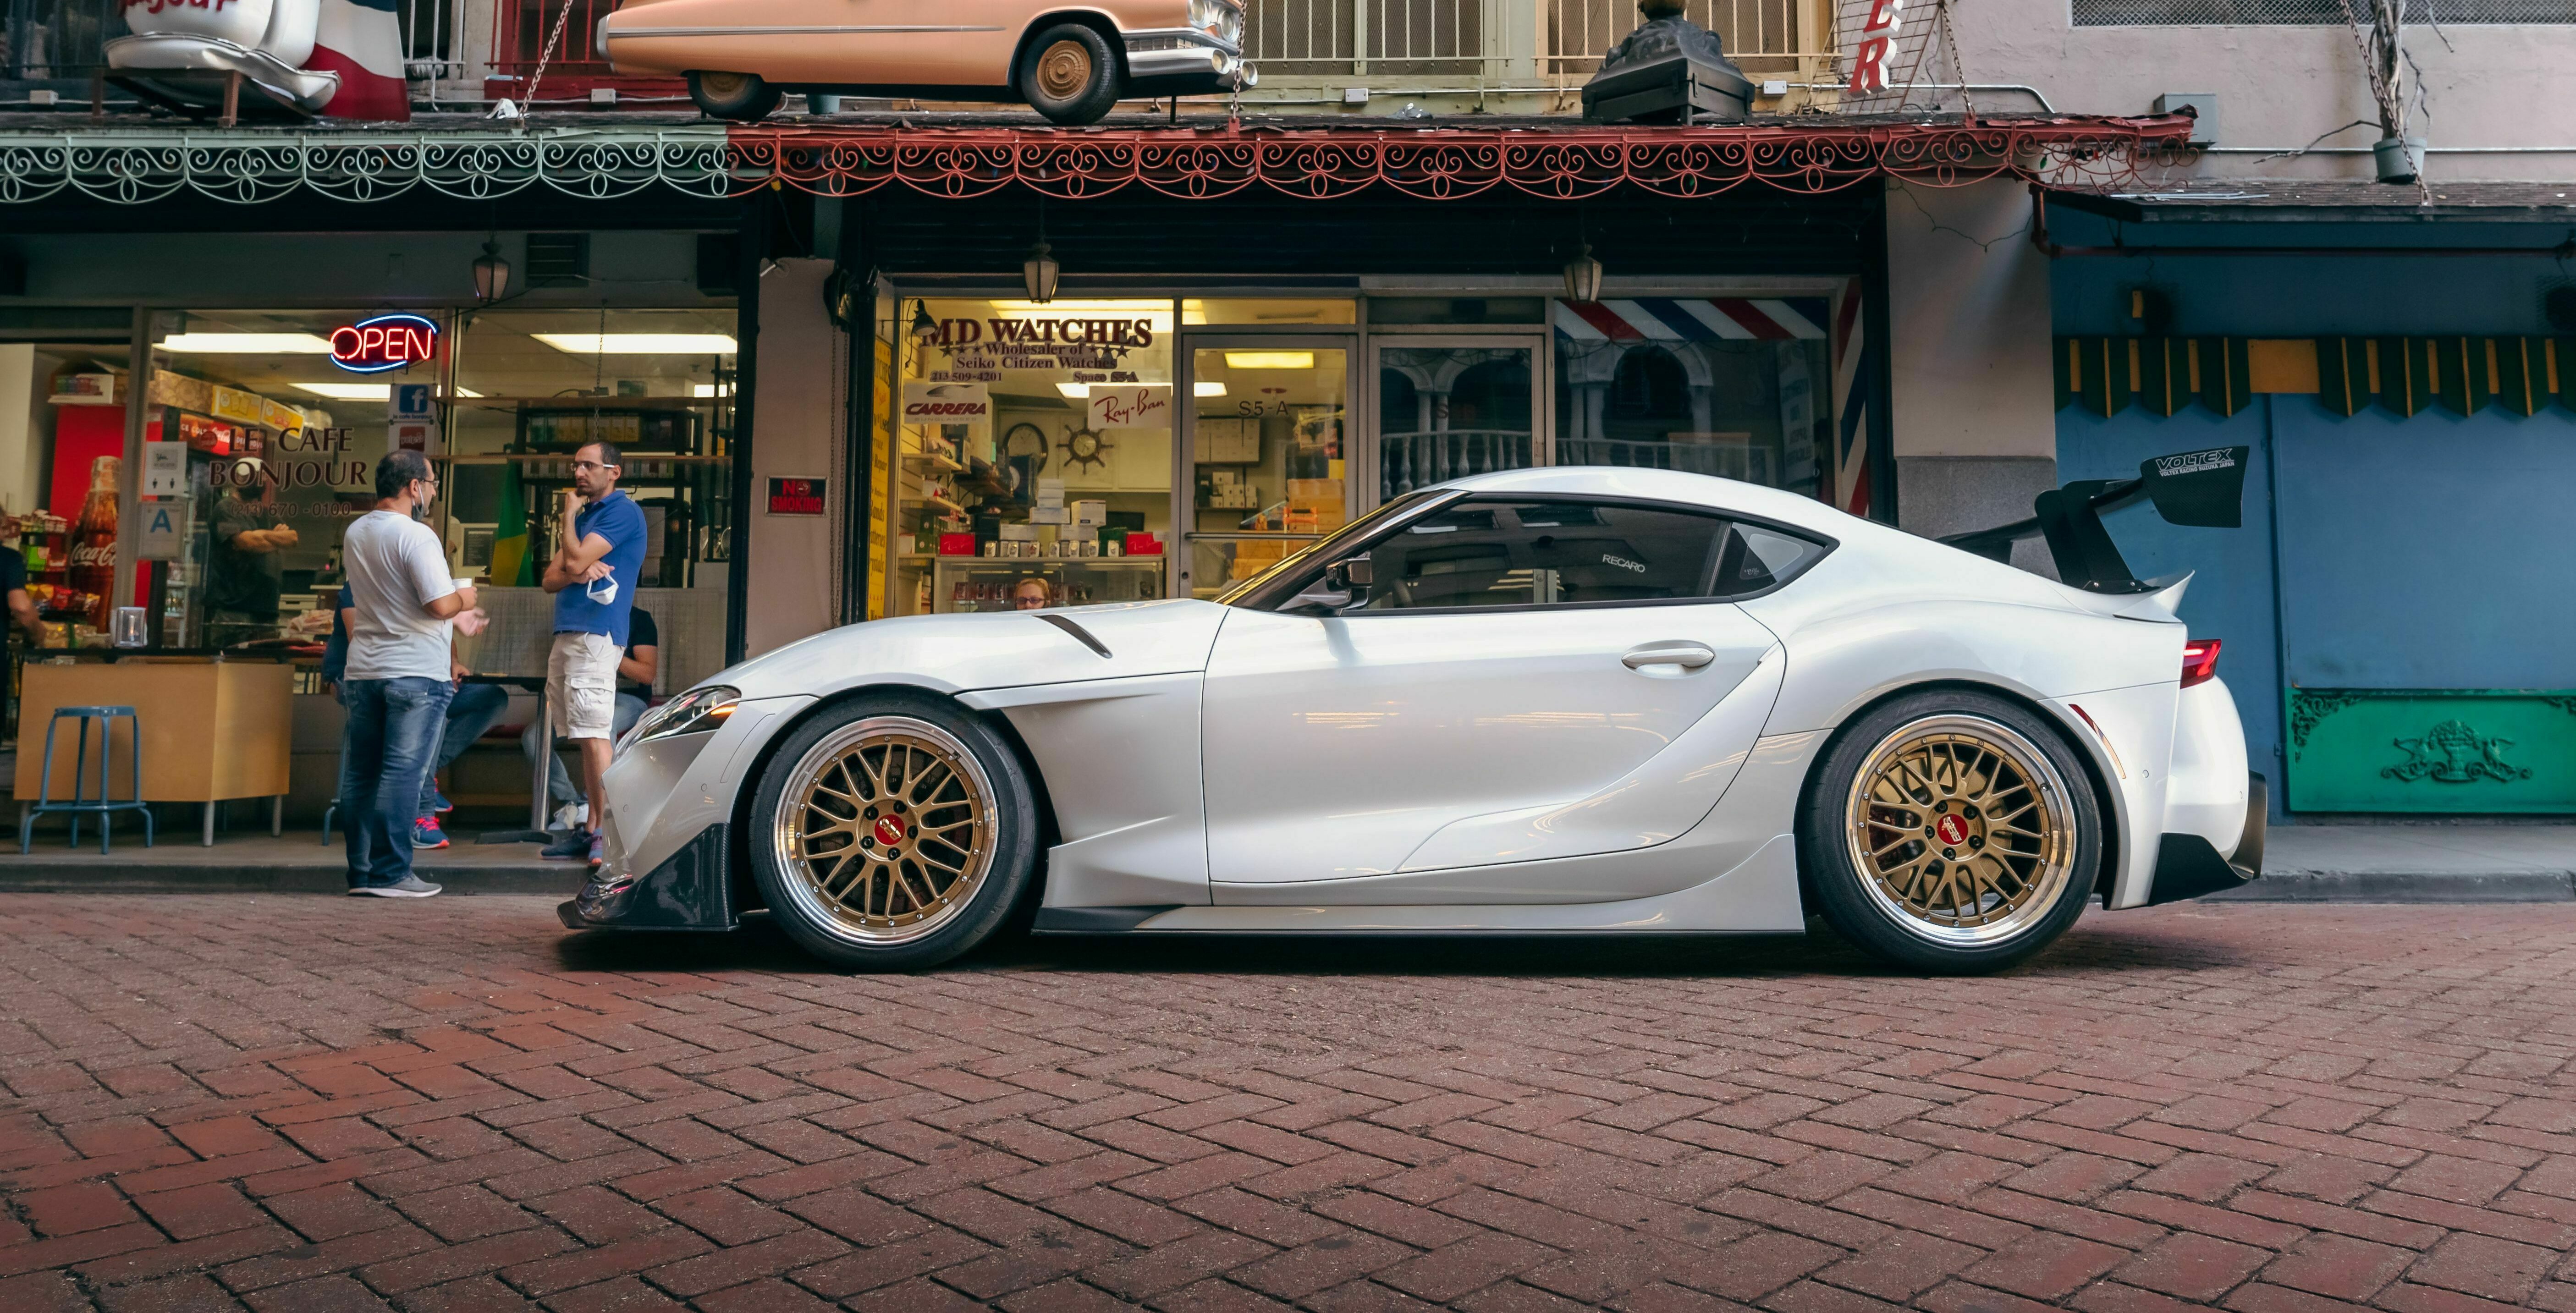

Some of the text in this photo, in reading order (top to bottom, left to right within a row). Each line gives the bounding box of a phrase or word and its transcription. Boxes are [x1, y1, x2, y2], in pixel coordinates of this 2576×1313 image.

[921, 319, 1152, 348] MD WATCHES
[330, 326, 432, 360] OPEN
[985, 342, 1085, 355] Wholesaler of
[957, 356, 1117, 368] Seiko Citizen Watches
[931, 372, 1002, 381] 213 509-4201
[1074, 372, 1107, 384] Space
[906, 403, 986, 415] CARRERA
[1094, 389, 1165, 424] Ray-Ban
[1238, 401, 1288, 416] S5-A
[229, 427, 354, 452] LE CAFE
[2156, 448, 2233, 472] VOLTEX
[209, 461, 368, 492] BONJOUR
[231, 501, 264, 516] (213)
[771, 495, 822, 512] SMOKING
[149, 508, 173, 533] A
[1602, 554, 1646, 573] RECARO
